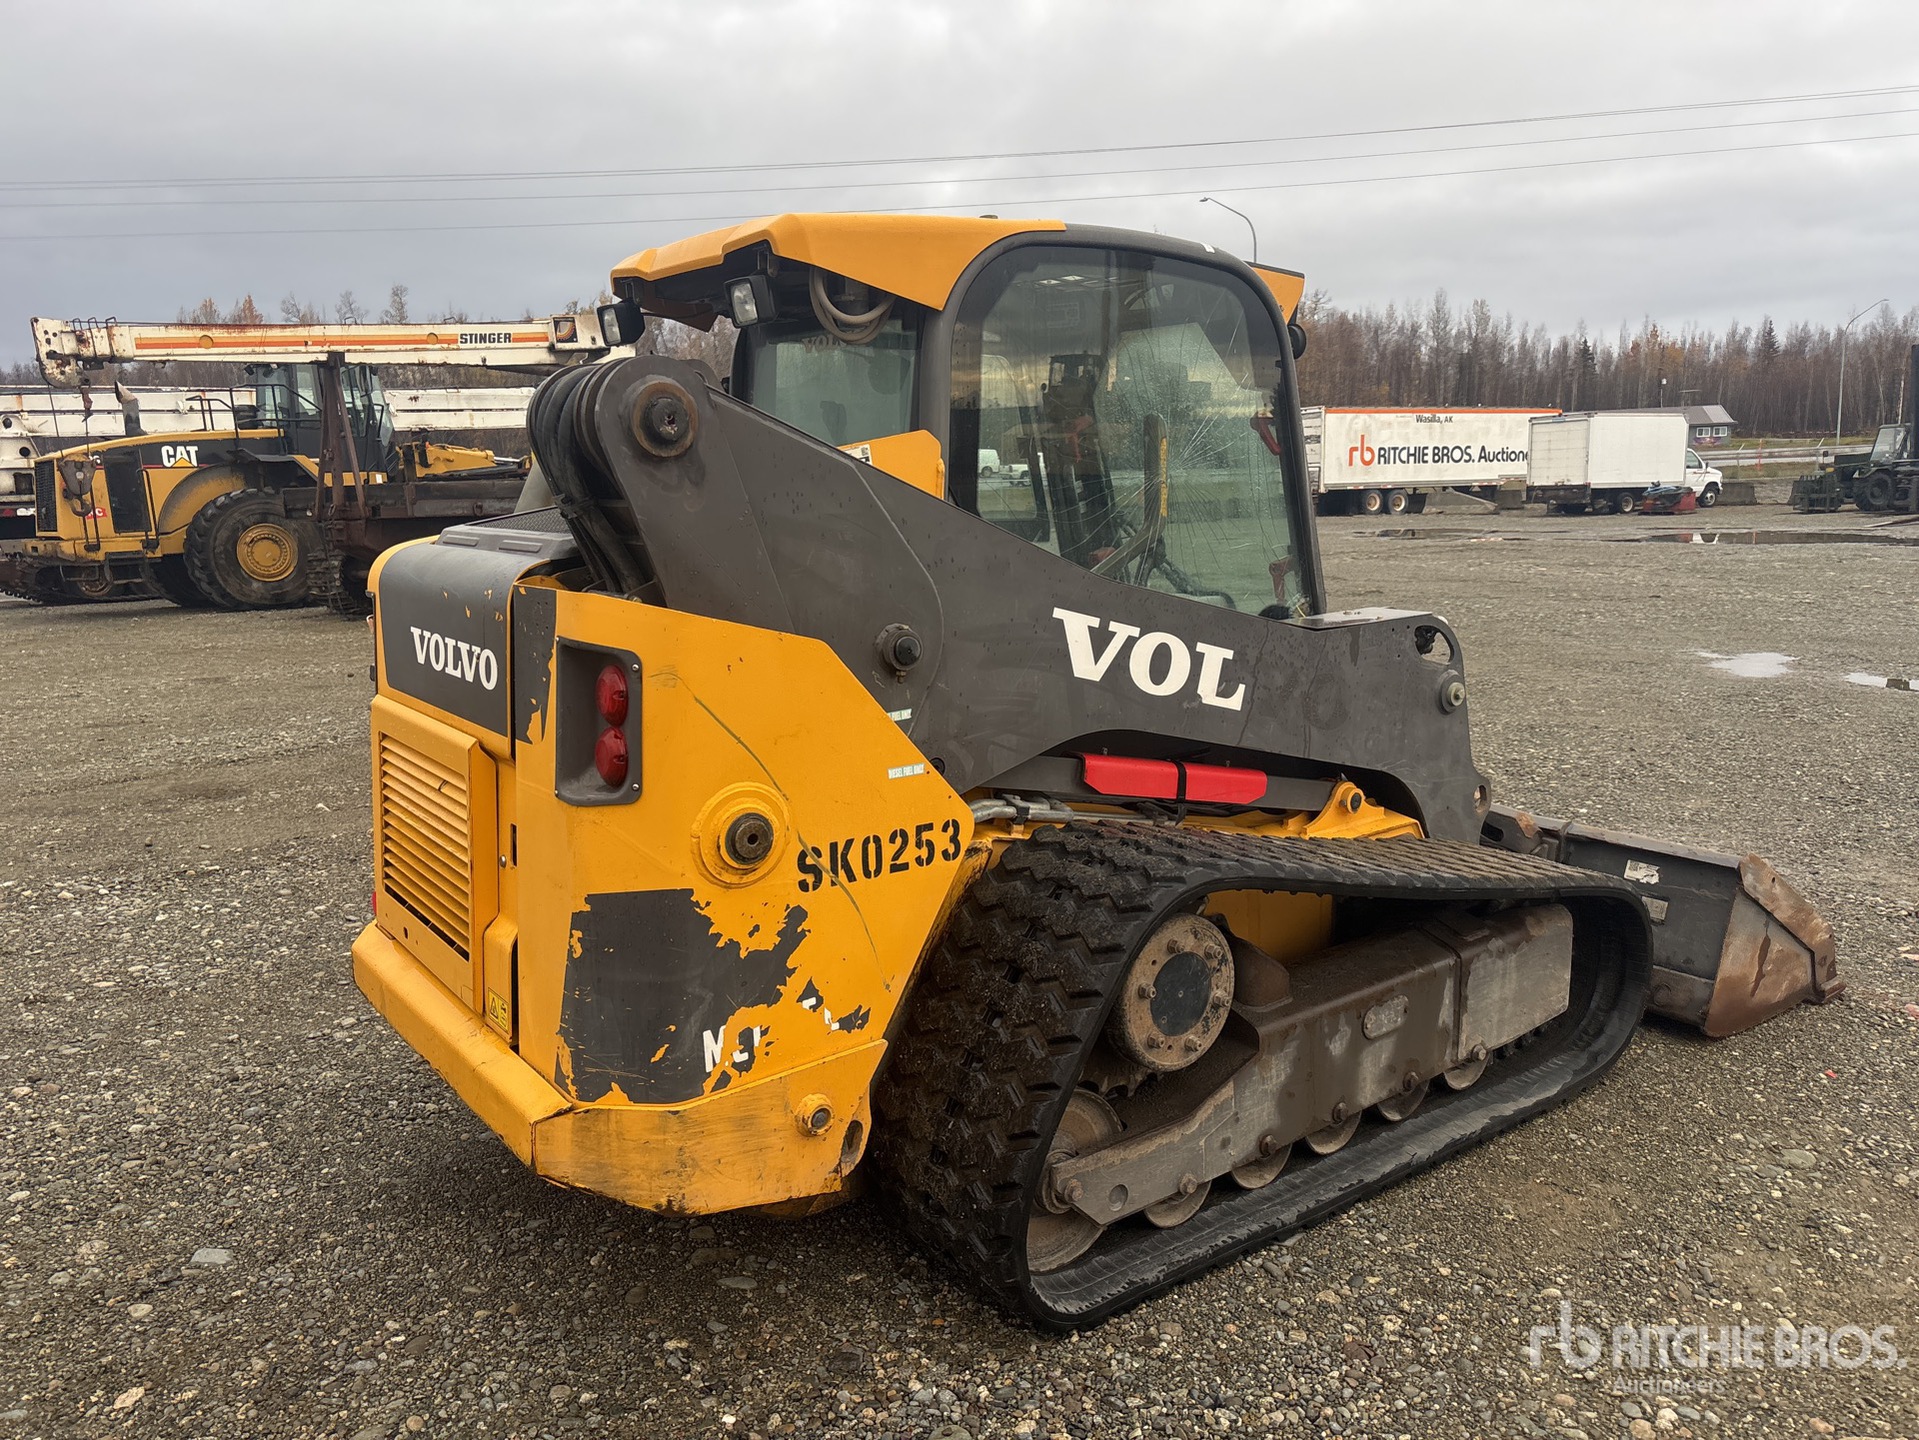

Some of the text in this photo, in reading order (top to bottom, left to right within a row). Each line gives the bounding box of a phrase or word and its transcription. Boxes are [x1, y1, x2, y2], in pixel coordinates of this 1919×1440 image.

[460, 332, 512, 345] STINGER
[1415, 414, 1443, 425] Wasilla,
[1444, 415, 1453, 424] AK
[161, 445, 199, 468] CAT
[1348, 434, 1375, 467] rb
[1377, 446, 1429, 465] RITCHIE
[1432, 445, 1475, 464] BROS.
[410, 626, 498, 691] VOLVO
[1052, 607, 1246, 711] VOL
[797, 818, 962, 893] SK0253
